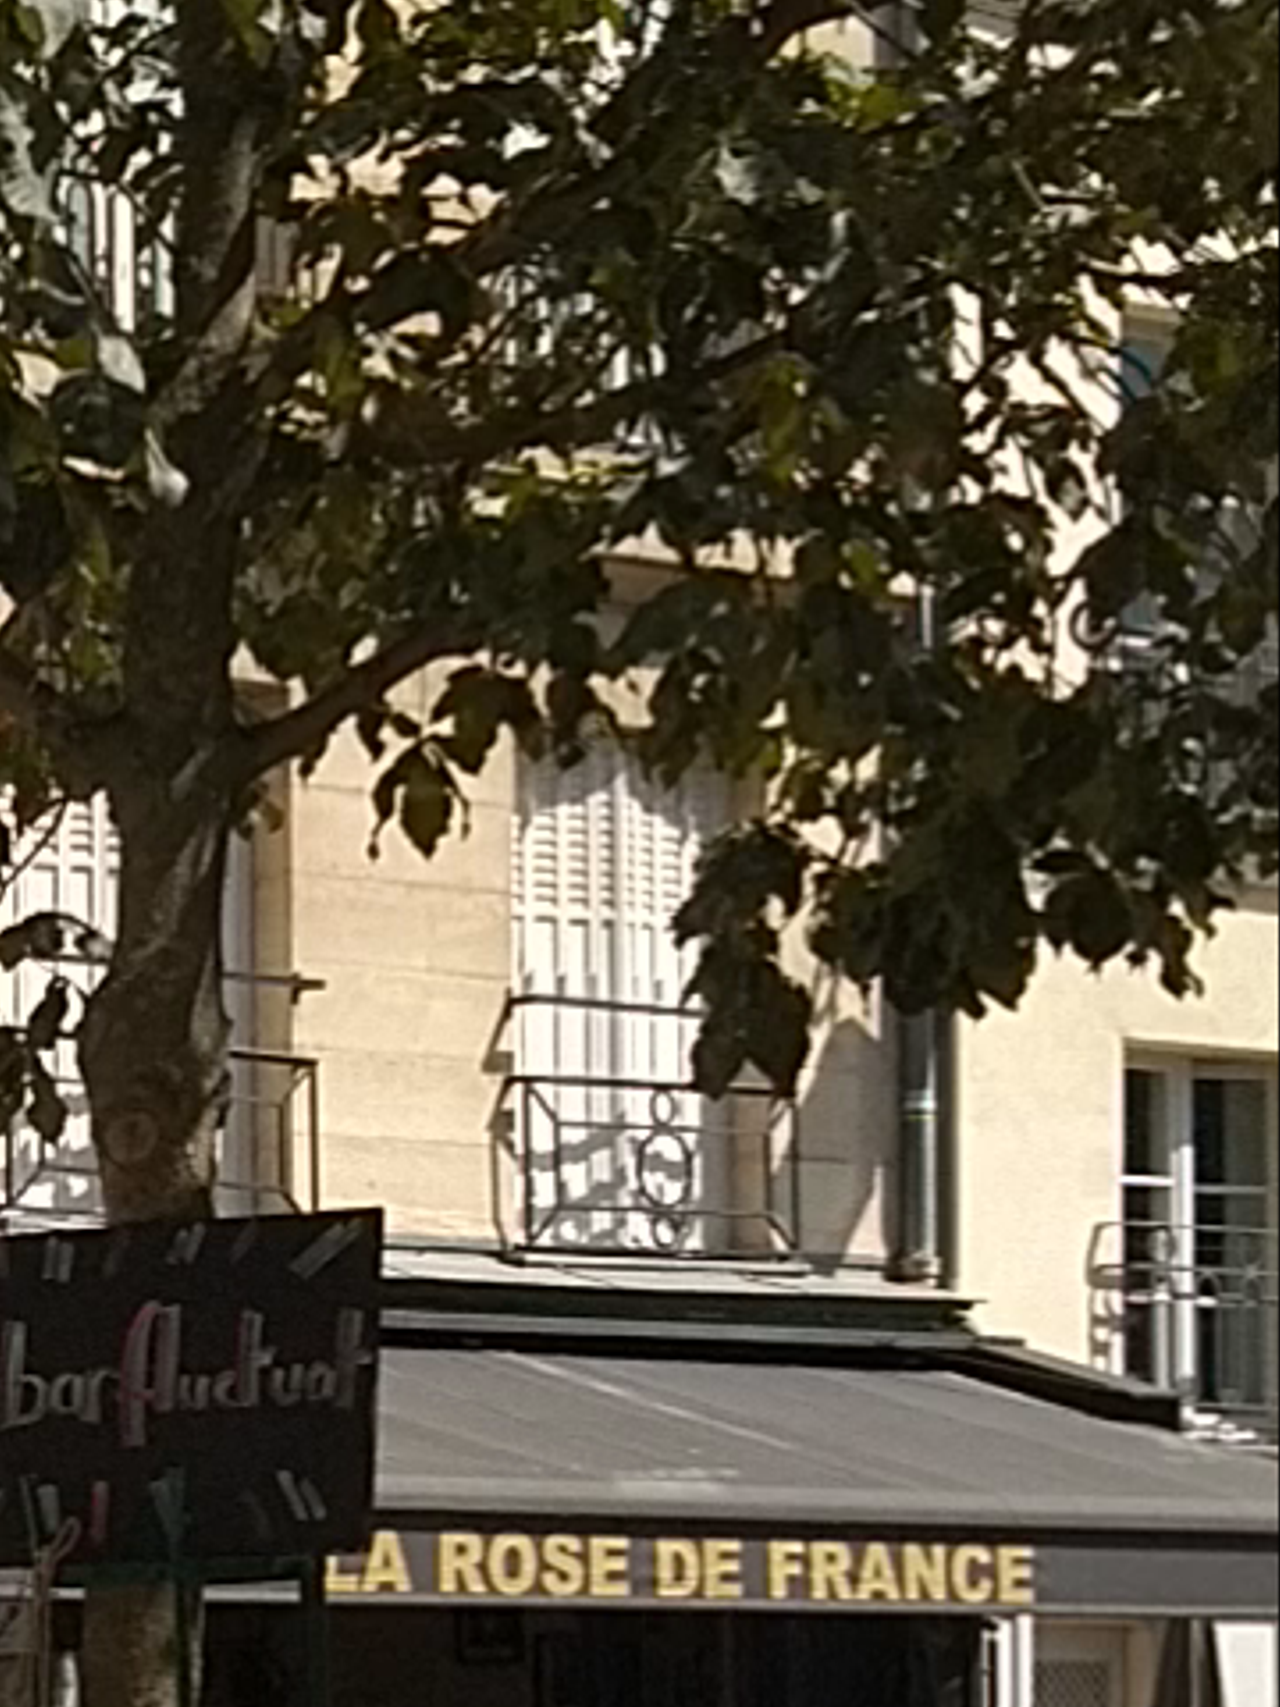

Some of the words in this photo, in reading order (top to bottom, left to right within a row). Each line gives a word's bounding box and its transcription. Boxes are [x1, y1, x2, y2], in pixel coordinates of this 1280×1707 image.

[439, 1532, 630, 1595] ROSE
[655, 1538, 743, 1598] DE
[768, 1541, 1035, 1603] FRANCE
